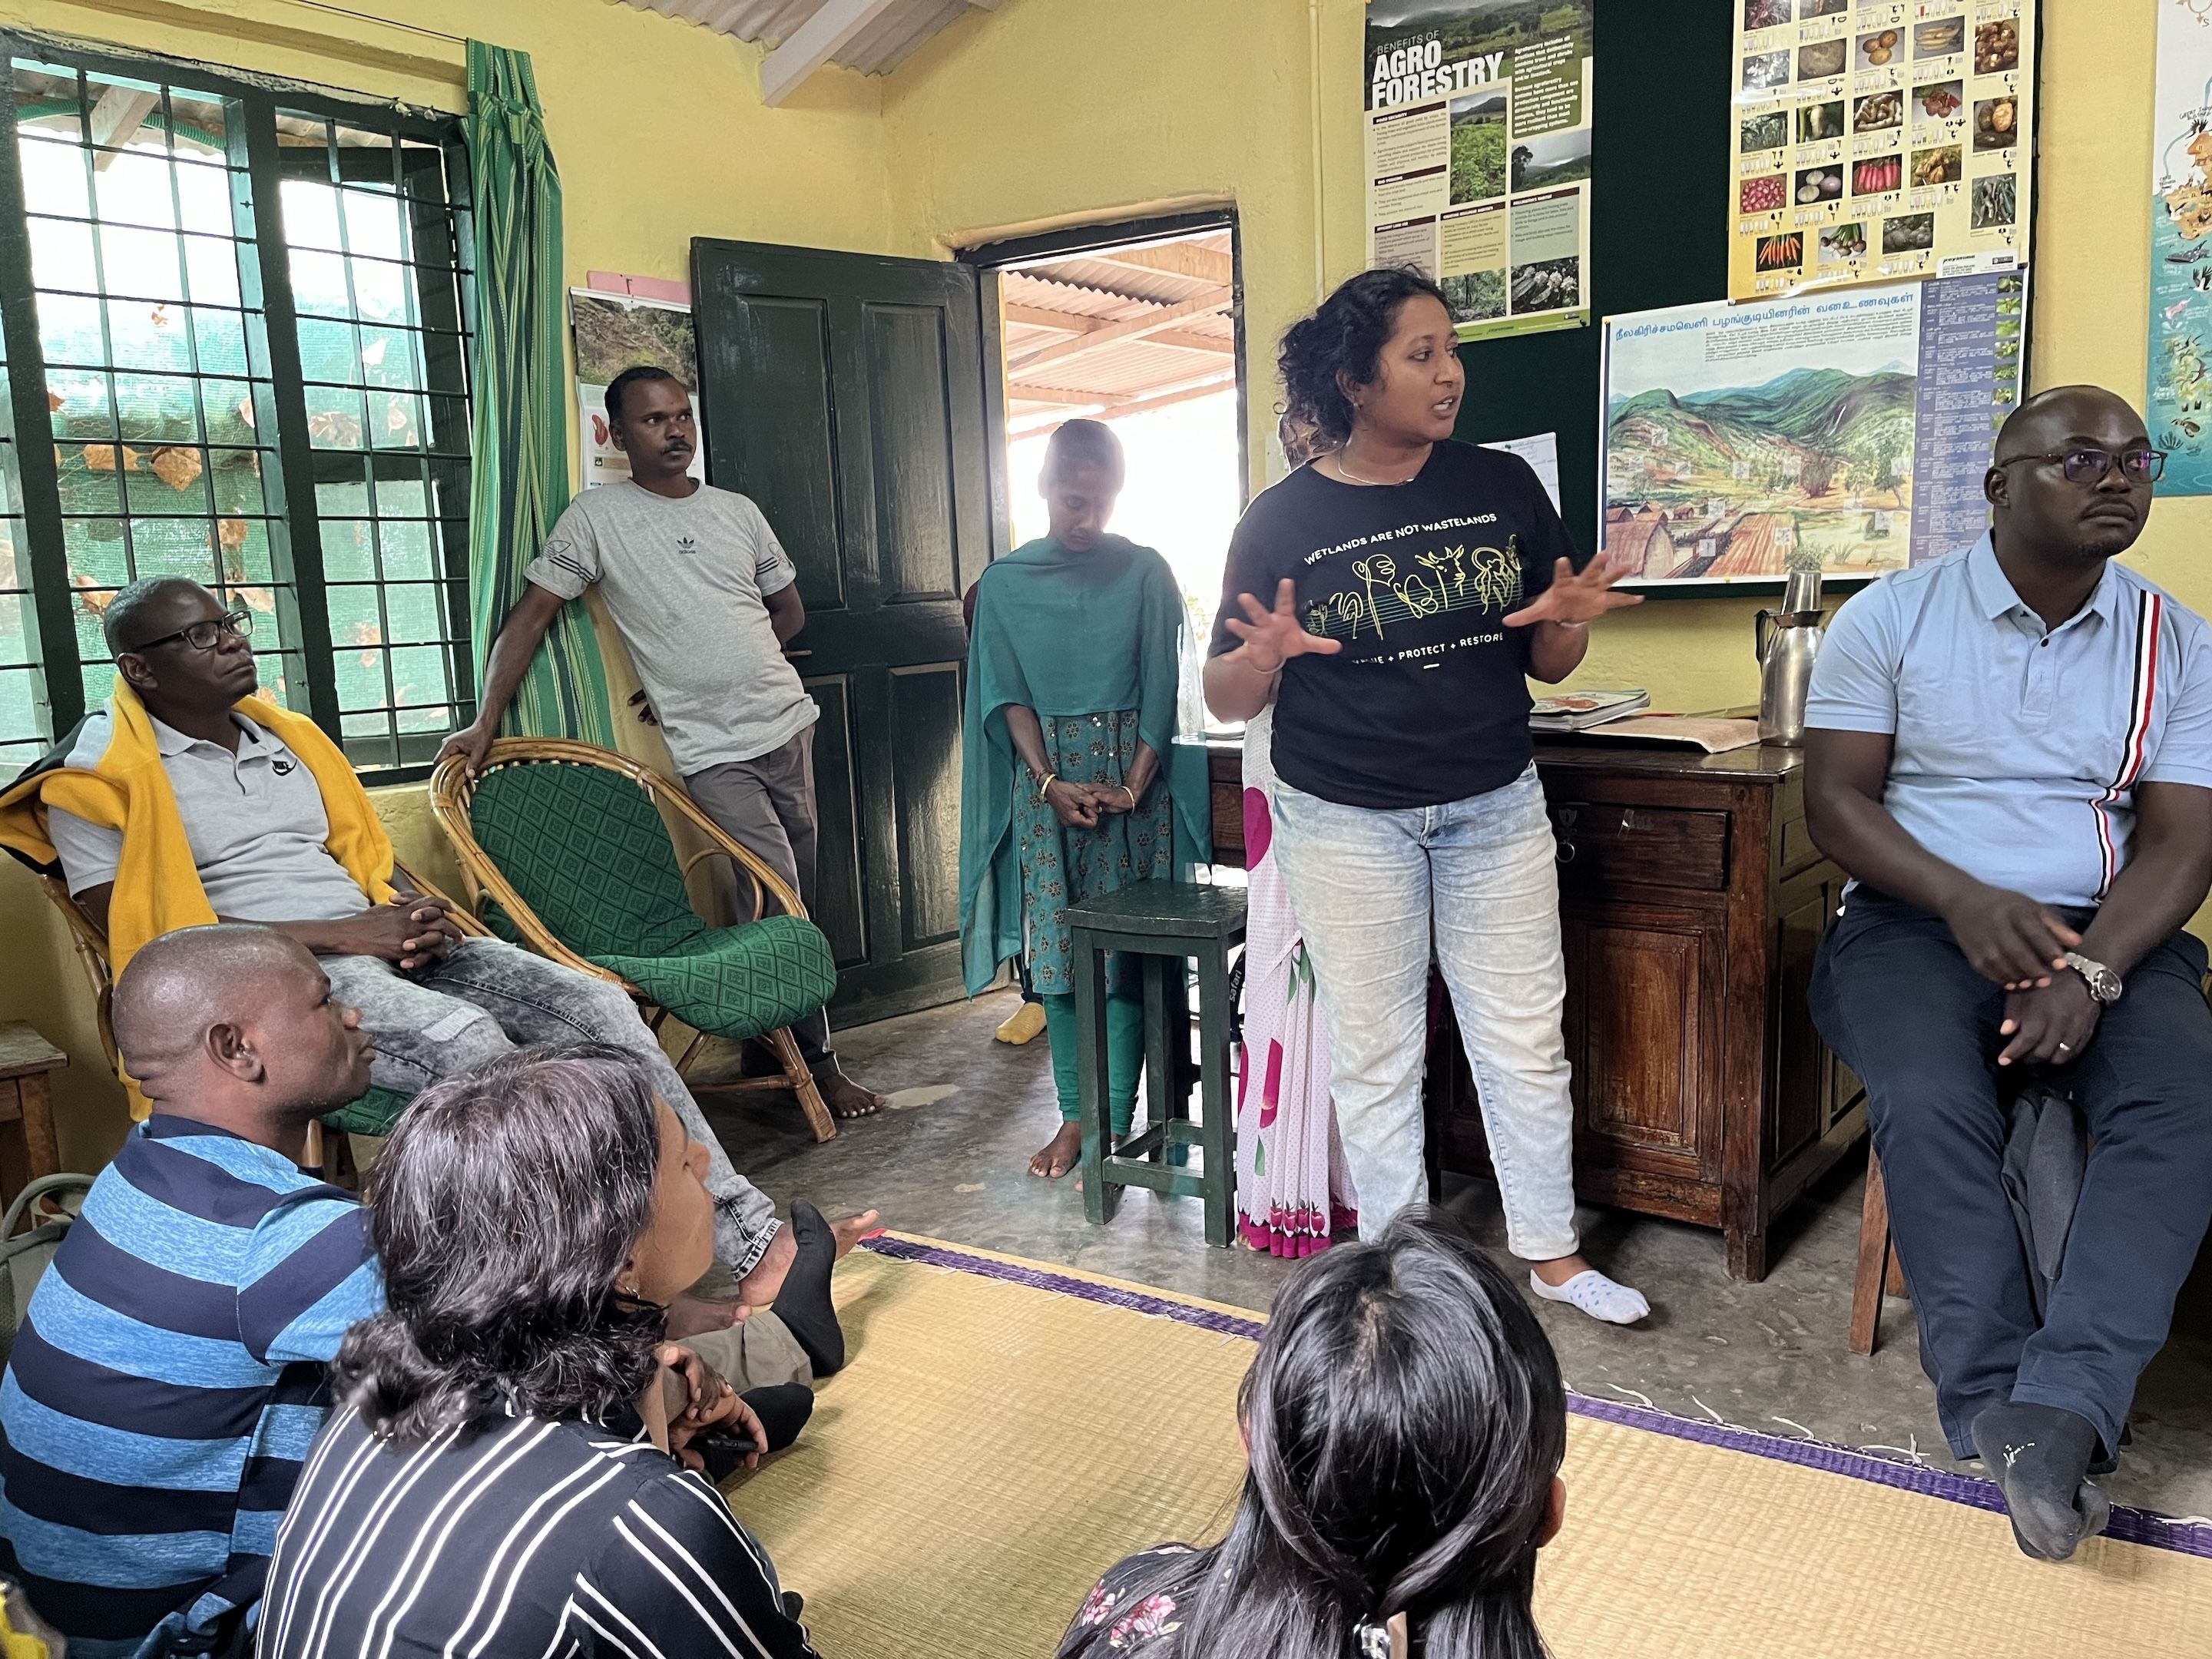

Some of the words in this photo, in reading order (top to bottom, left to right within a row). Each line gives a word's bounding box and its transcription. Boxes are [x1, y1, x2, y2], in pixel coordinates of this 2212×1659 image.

[1373, 40, 1442, 83] AGRO
[1377, 34, 1423, 55] BENEFITS
[1426, 30, 1439, 41] OF
[1373, 51, 1504, 110] FORESTRY
[1304, 537, 1368, 565] WETLANDS
[1370, 531, 1394, 544] ARE
[1395, 524, 1419, 538] NOT
[1421, 513, 1497, 531] WASTELANDS
[1399, 644, 1445, 660] PROTECT
